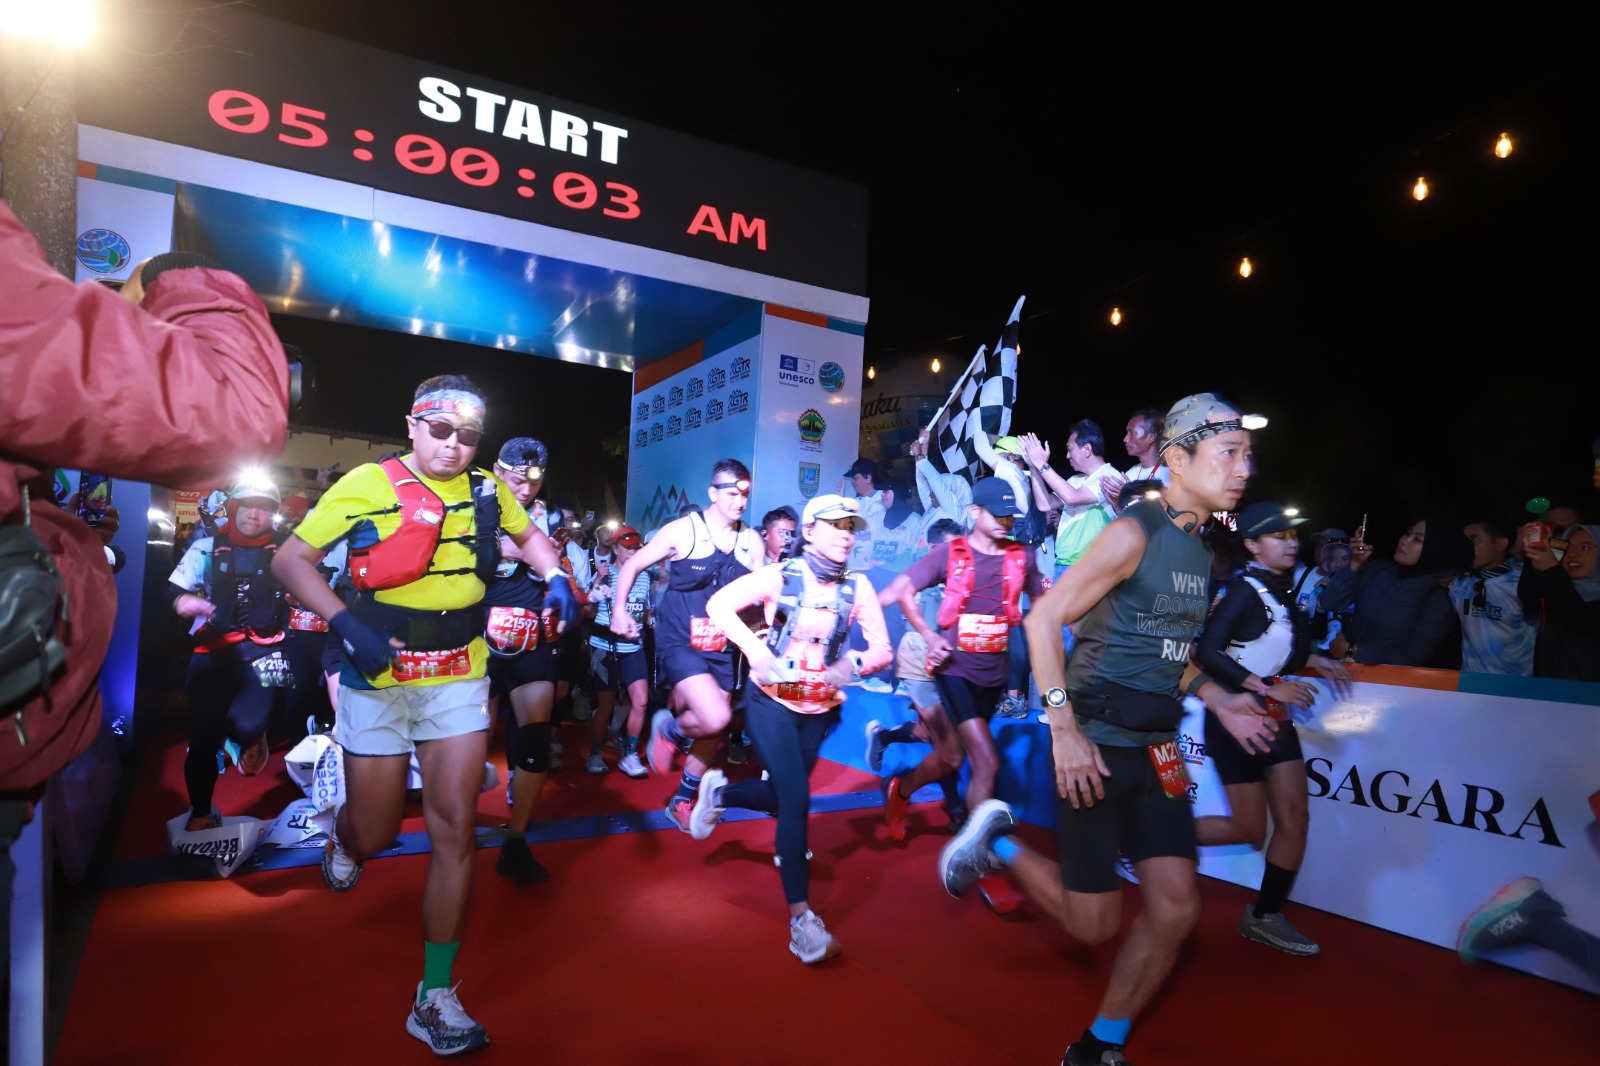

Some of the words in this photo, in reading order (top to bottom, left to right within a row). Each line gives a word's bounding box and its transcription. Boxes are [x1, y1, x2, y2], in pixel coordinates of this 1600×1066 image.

[418, 77, 628, 165] START
[686, 204, 767, 250] AM
[779, 371, 815, 385] unesco
[1172, 571, 1205, 596] WHY
[1152, 594, 1184, 616] DO
[1186, 598, 1206, 621] YO
[490, 614, 538, 631] M21597
[1153, 740, 1180, 766] M21
[1304, 757, 1567, 849] SAGARA
